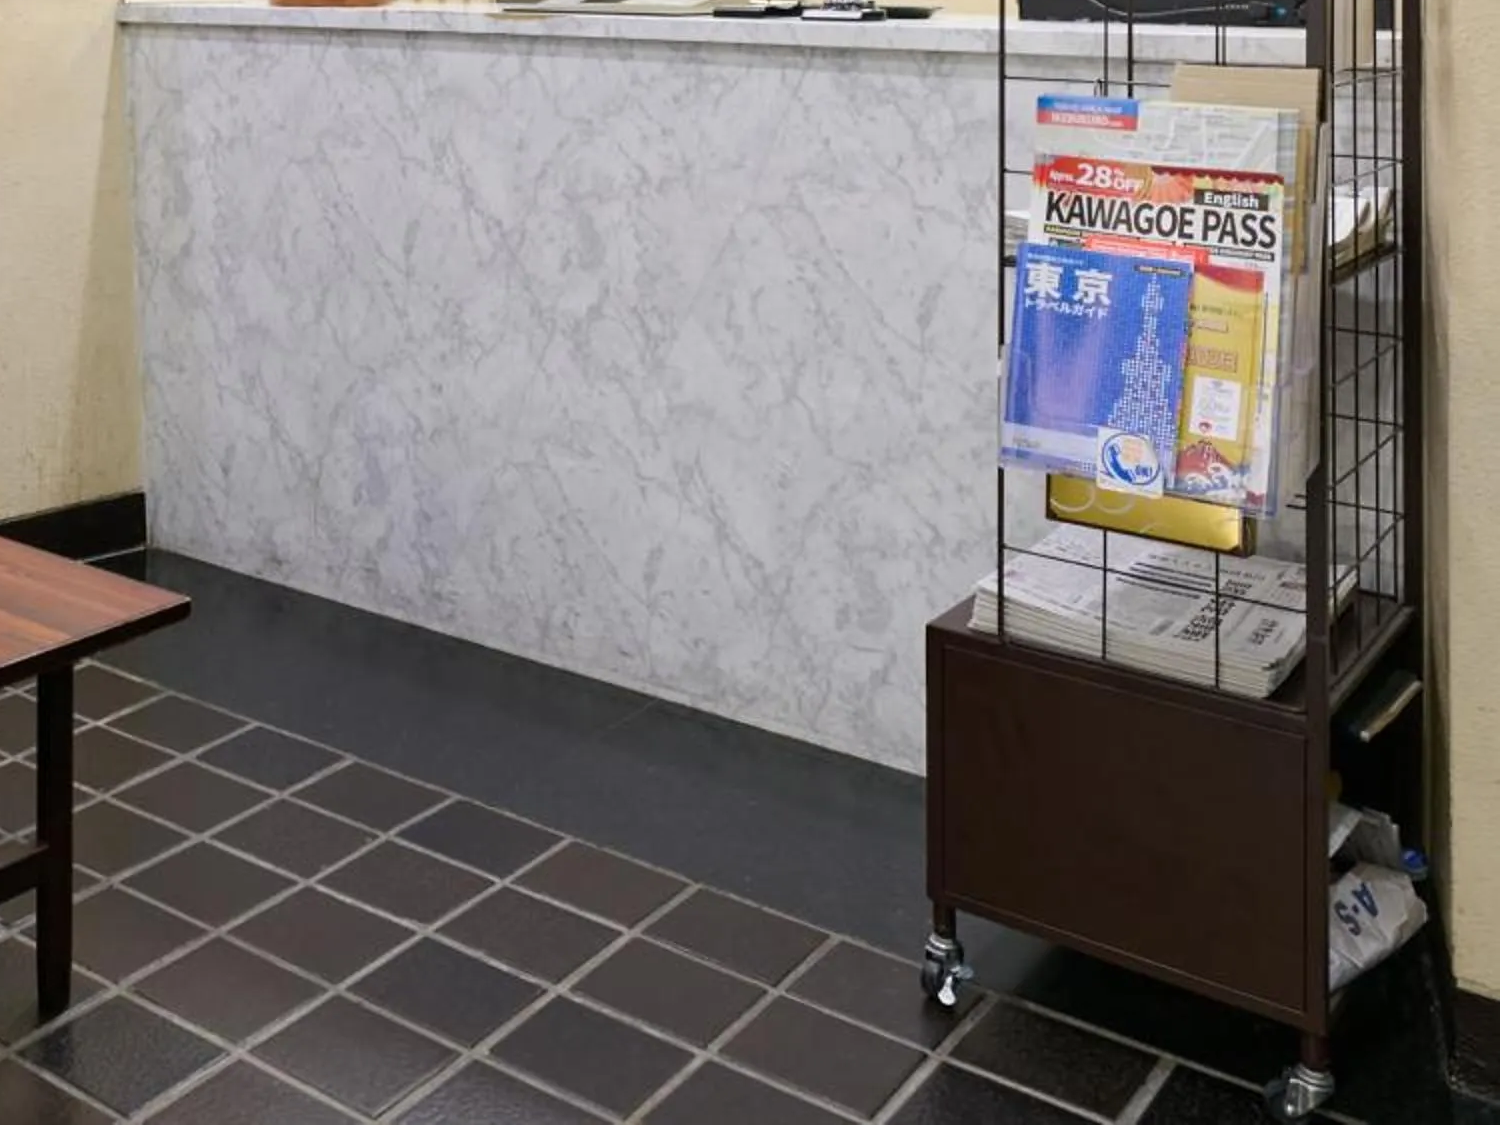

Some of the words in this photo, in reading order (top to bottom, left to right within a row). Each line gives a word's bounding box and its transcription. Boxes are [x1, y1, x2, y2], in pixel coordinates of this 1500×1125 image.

[1204, 192, 1260, 209] English
[1045, 190, 1195, 240] KAWAGOE
[1202, 210, 1277, 250] PASS
[1024, 262, 1113, 305] 東京
[1025, 296, 1109, 319] トラベルガイド
